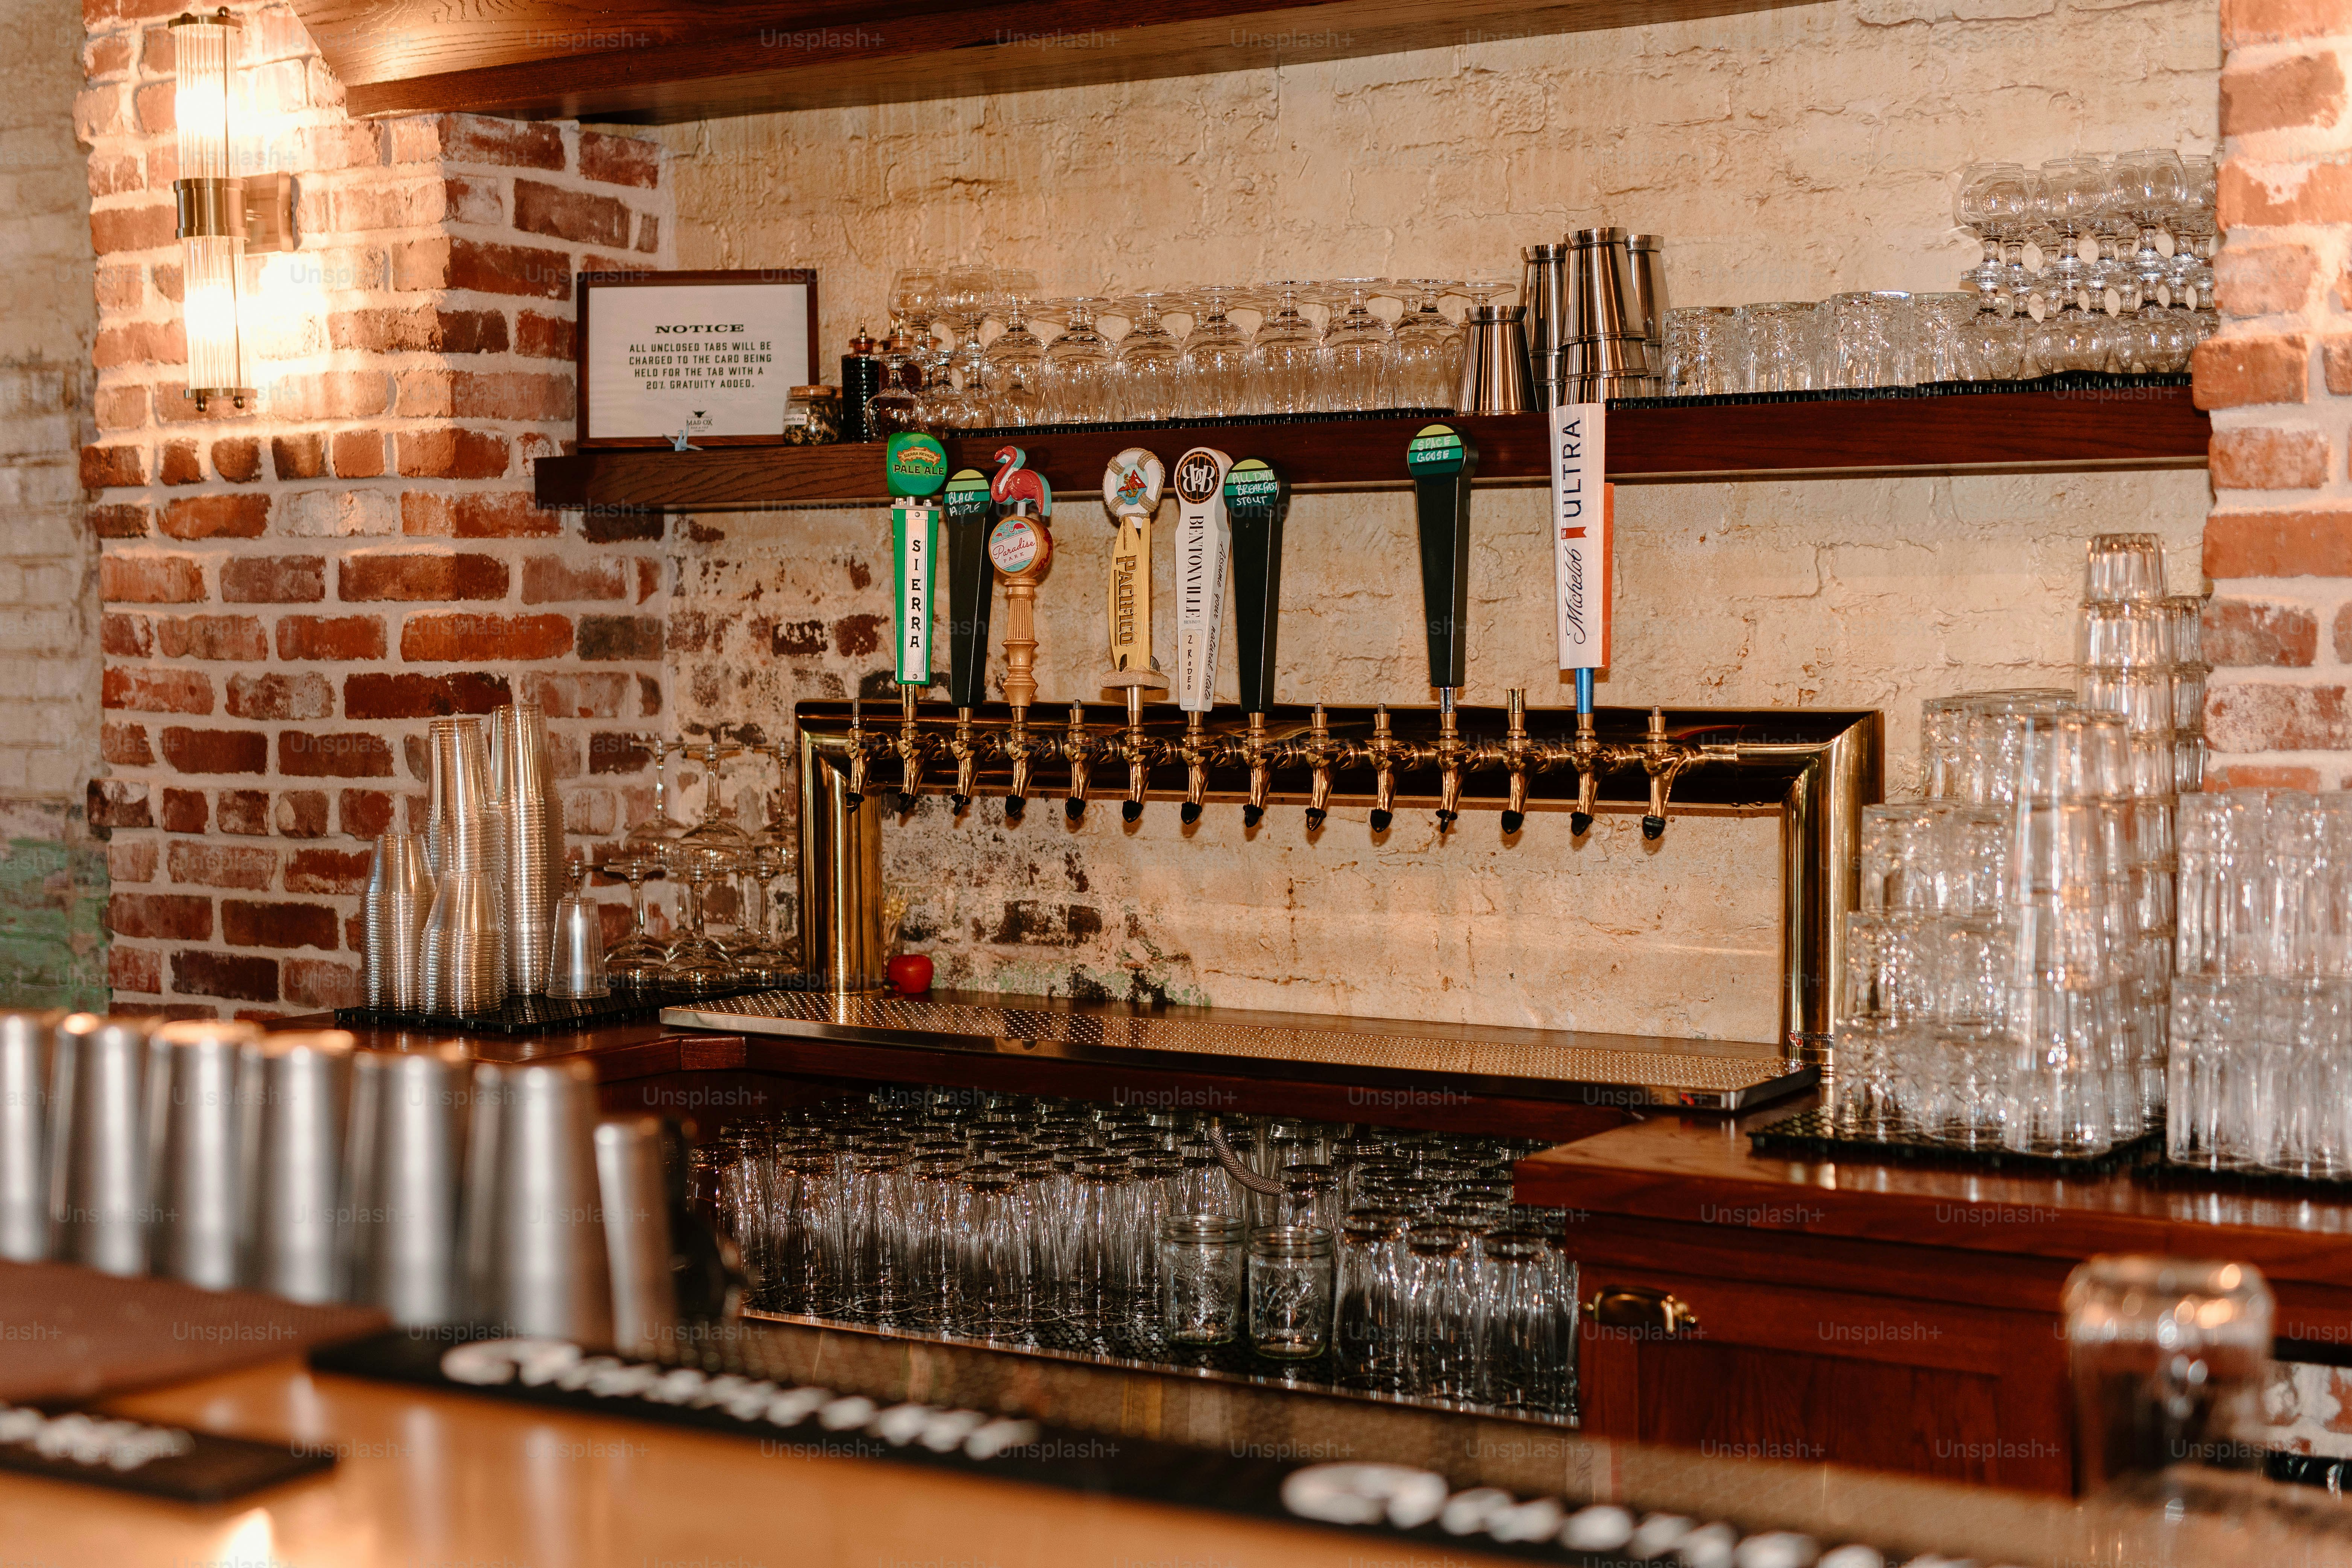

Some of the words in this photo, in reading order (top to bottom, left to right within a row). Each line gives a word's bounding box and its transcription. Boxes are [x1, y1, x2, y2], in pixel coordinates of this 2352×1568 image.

[656, 324, 744, 334] NOTICE
[630, 344, 646, 352] ALL
[651, 343, 699, 352] UNCLOSED
[704, 342, 727, 351] TABS
[732, 342, 755, 351] WILL
[760, 342, 771, 350] BE
[629, 356, 672, 365] CHARGED
[677, 355, 688, 364] TO
[693, 355, 710, 364] THE
[715, 354, 739, 363] CARD
[744, 354, 771, 363] BEING
[635, 368, 658, 377] HELD
[663, 368, 680, 376] FOR
[685, 367, 701, 376] THE
[707, 367, 724, 376] TAB
[728, 367, 753, 375] WITH
[646, 381, 666, 389] 20%
[670, 379, 715, 389] GRATUITY
[720, 379, 754, 388] ADDED.
[1417, 436, 1451, 451] SPACE
[1417, 450, 1449, 463] GOOSE
[893, 464, 921, 474] PALE
[924, 466, 945, 475] ALE
[1562, 418, 1581, 518] ULTRA
[1232, 472, 1252, 484] ALL
[1254, 469, 1273, 482] DAY
[1236, 481, 1278, 495] BREAKFAST
[948, 491, 974, 504] BLACK
[1237, 496, 1267, 505] STOUT
[992, 537, 1035, 560] Paradise
[1003, 552, 1024, 563] PARK
[1217, 540, 1227, 589] Assume
[1185, 515, 1204, 618] BENTONVILLE
[909, 540, 921, 648] SIERRA
[1116, 554, 1138, 647] PACIFICO
[1565, 545, 1586, 645] Michelob
[1208, 625, 1216, 671] natural
[1204, 672, 1212, 701] state
